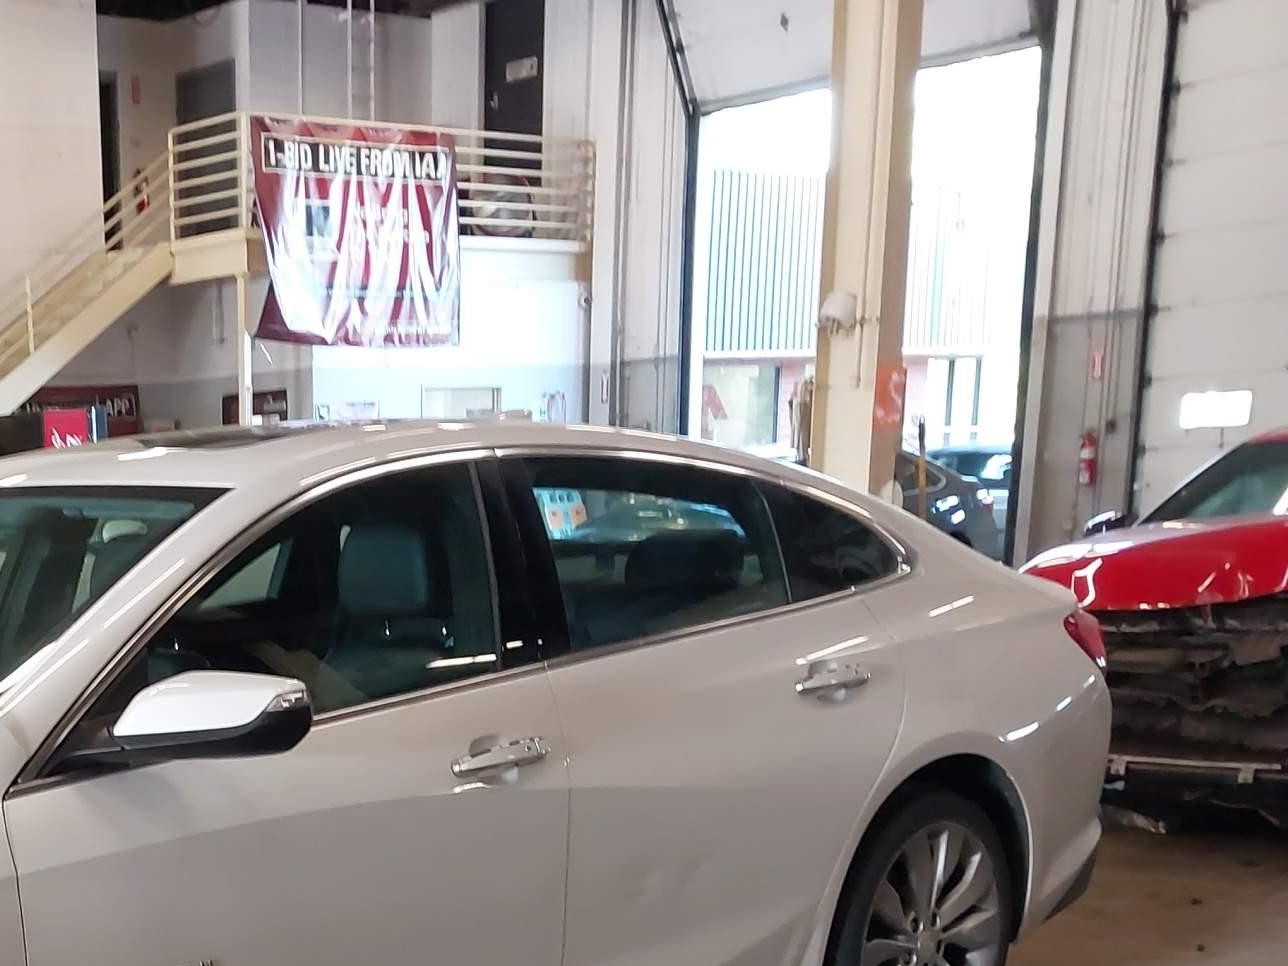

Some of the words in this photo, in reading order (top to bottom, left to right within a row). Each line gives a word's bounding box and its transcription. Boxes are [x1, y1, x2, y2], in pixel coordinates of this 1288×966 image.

[268, 138, 313, 171] I-BID
[318, 143, 356, 175] LIVE
[361, 147, 411, 180] FROM
